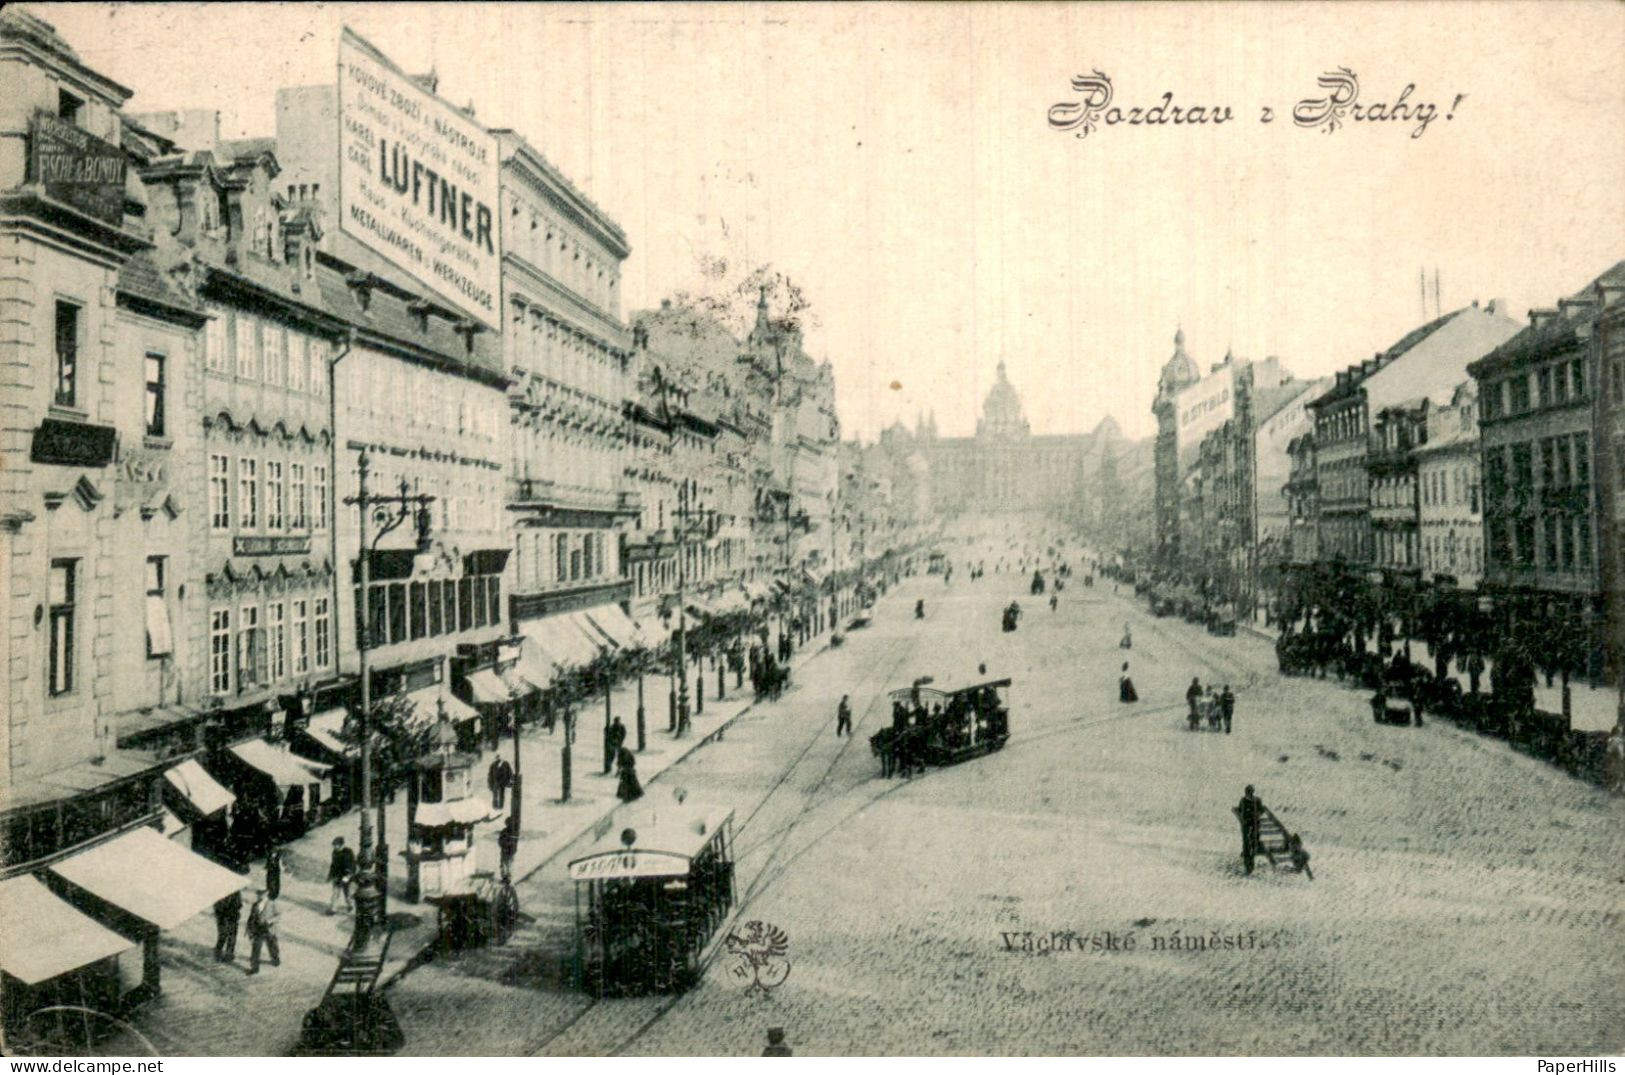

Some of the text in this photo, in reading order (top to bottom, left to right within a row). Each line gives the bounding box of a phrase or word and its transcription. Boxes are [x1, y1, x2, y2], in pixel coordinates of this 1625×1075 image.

[345, 113, 376, 149] KAREL
[347, 145, 373, 175] CARL
[348, 63, 388, 100] KOVOVÉ
[389, 87, 422, 122] ZBOŽÍ
[434, 116, 487, 165] NÁSTROJE
[379, 137, 494, 257] LÜFTNER
[350, 203, 423, 263] METALLWAREN
[432, 256, 494, 311] WERKZEUGE
